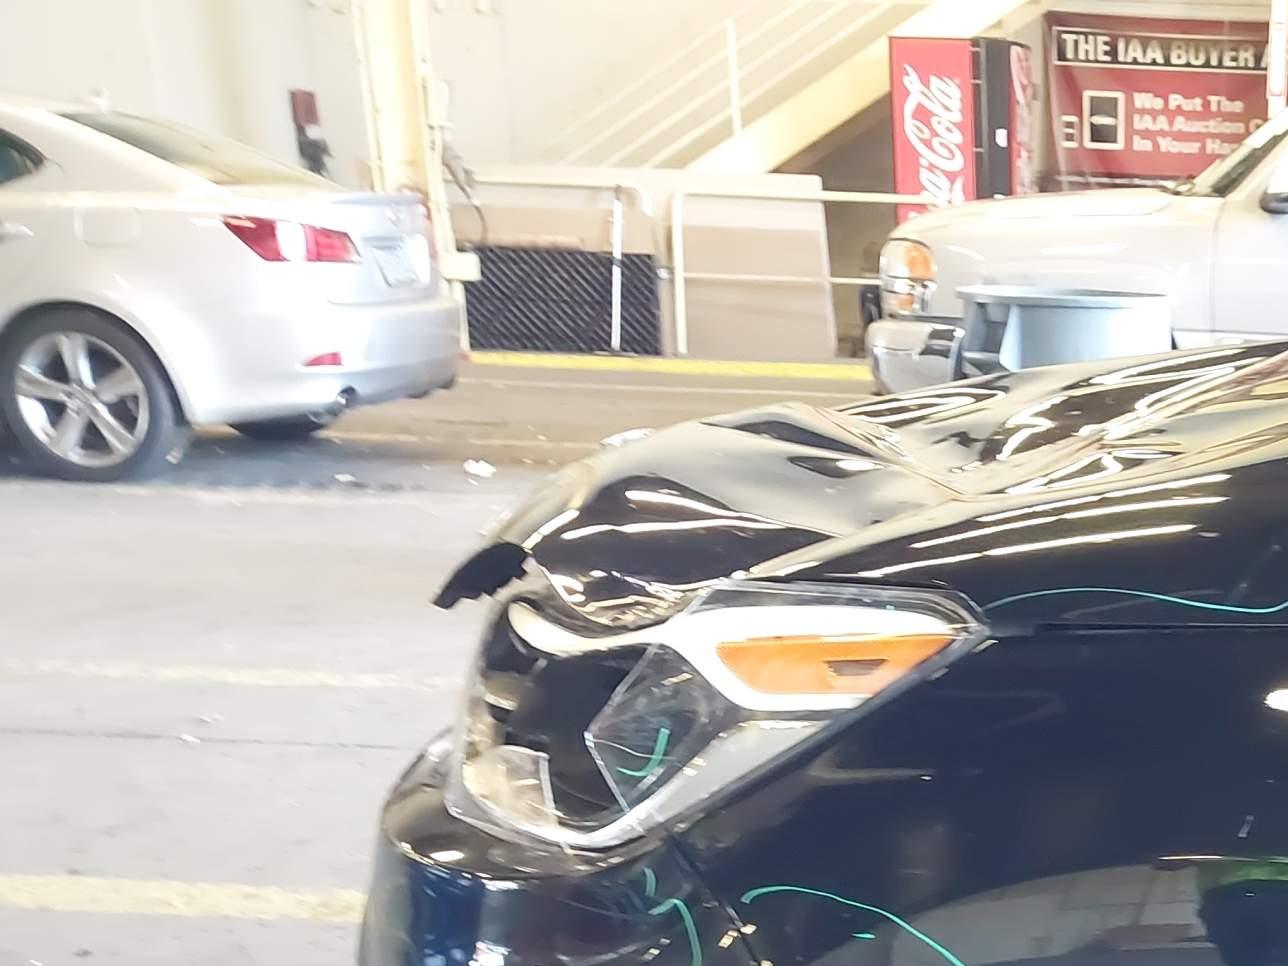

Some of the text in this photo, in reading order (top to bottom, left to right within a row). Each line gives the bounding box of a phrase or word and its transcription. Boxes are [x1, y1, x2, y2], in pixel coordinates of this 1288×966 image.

[1061, 33, 1112, 61] THE
[1117, 37, 1164, 64] IAA
[1170, 41, 1255, 68] BUYER
[1132, 92, 1244, 112] We Put The
[1132, 113, 1170, 131] IAA
[1172, 115, 1246, 133] Auction
[1132, 134, 1153, 151] In
[1156, 136, 1201, 154] Your
